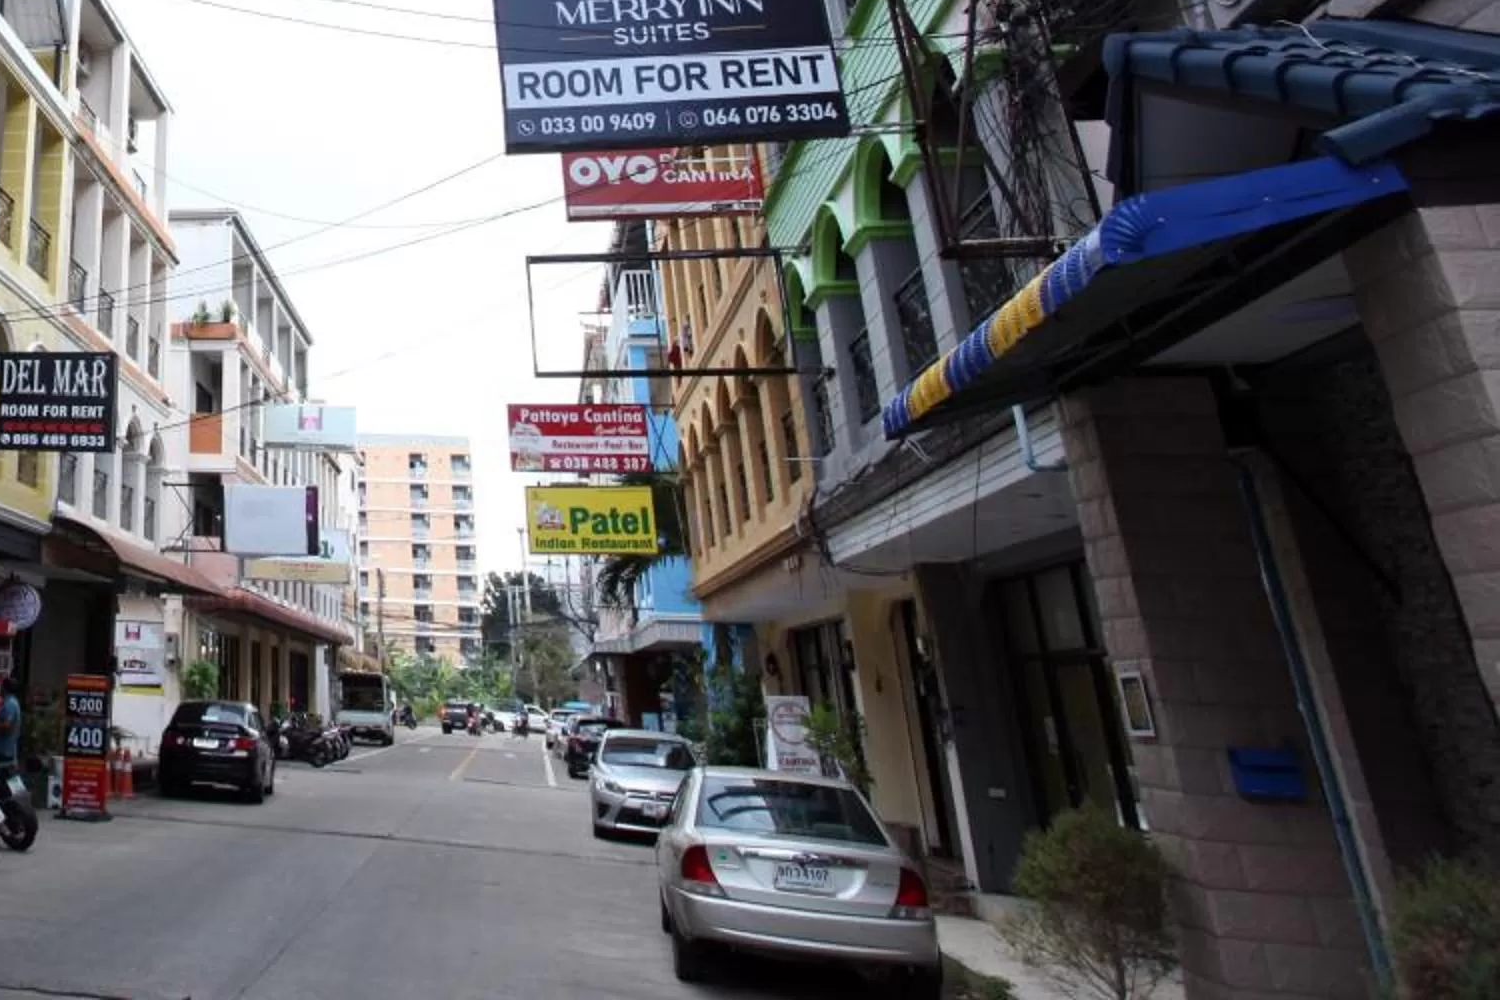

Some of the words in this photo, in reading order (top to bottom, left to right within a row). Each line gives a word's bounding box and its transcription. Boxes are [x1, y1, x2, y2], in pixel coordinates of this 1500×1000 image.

[613, 22, 711, 46] SUITES
[517, 66, 623, 101] ROOM
[634, 61, 711, 94] FOR
[719, 53, 825, 90] RENT
[541, 116, 576, 135] 033
[581, 114, 604, 133] 00
[609, 111, 656, 131] 9409
[703, 107, 740, 127] 064
[745, 105, 781, 124] 076
[787, 102, 837, 122] 3304
[569, 155, 658, 187] OYO
[1, 359, 46, 395] DEL
[52, 359, 108, 398] MAR
[1, 404, 39, 417] ROOM
[42, 405, 67, 417] FOR
[71, 405, 105, 418] RENT
[520, 407, 579, 427] Pattaya
[583, 407, 643, 423] Cantina
[569, 506, 651, 535] Patel
[535, 536, 576, 549] Indian
[582, 537, 653, 549] Restaurant
[68, 727, 103, 747] 400
